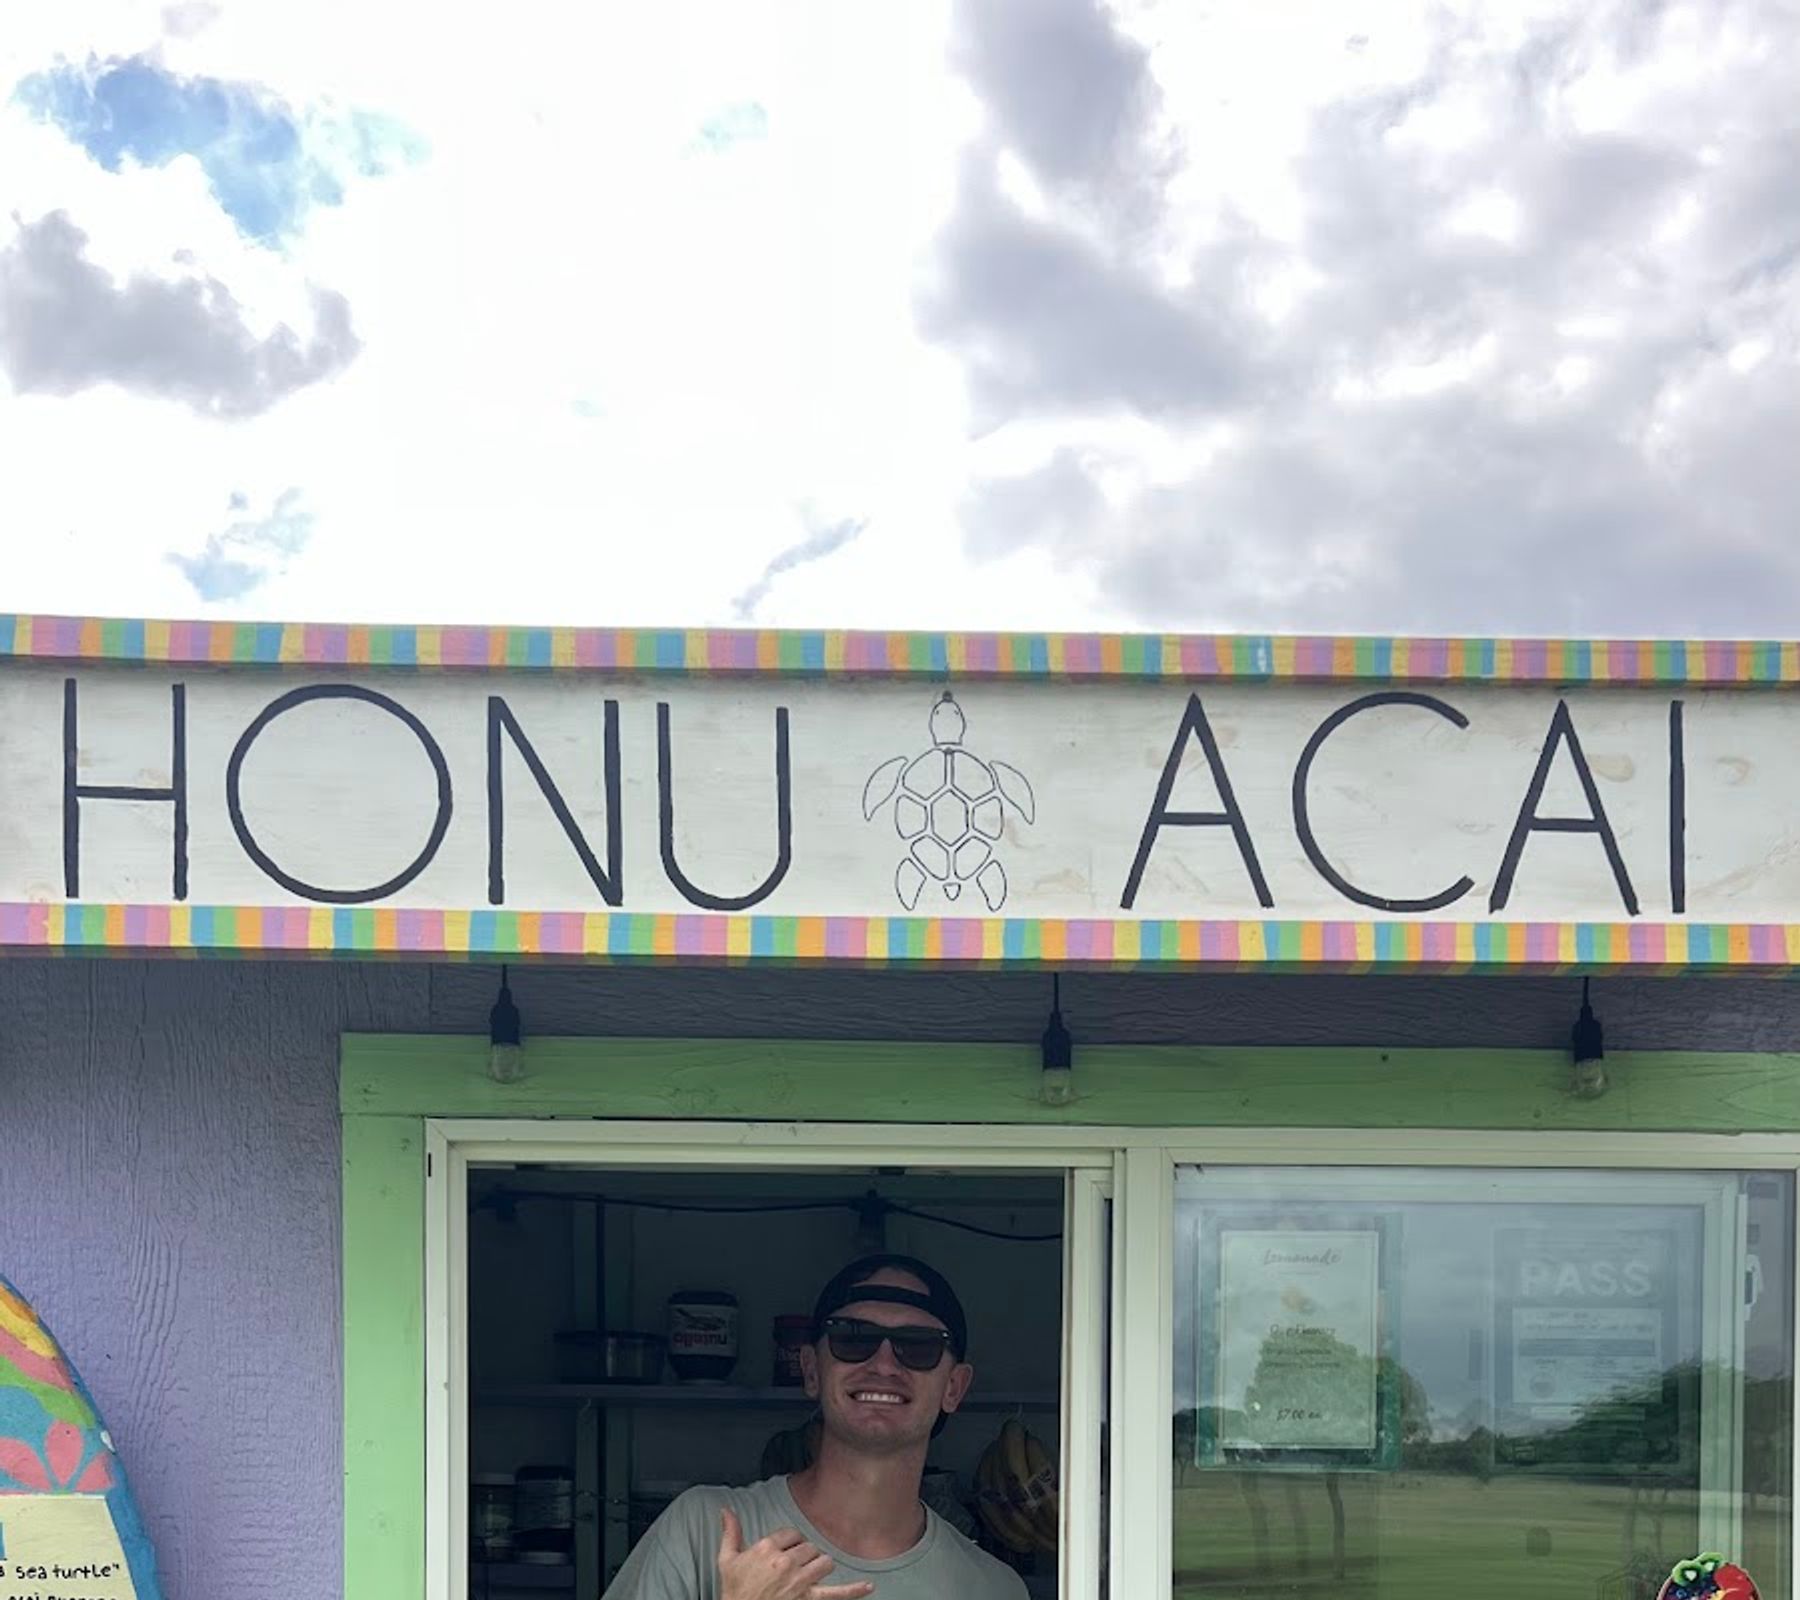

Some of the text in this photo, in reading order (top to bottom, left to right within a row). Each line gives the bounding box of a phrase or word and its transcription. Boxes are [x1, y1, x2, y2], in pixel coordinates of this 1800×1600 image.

[64, 678, 1685, 915] HONU ACAI
[1519, 1259, 1651, 1297] PASS
[16, 1566, 47, 1579] sea
